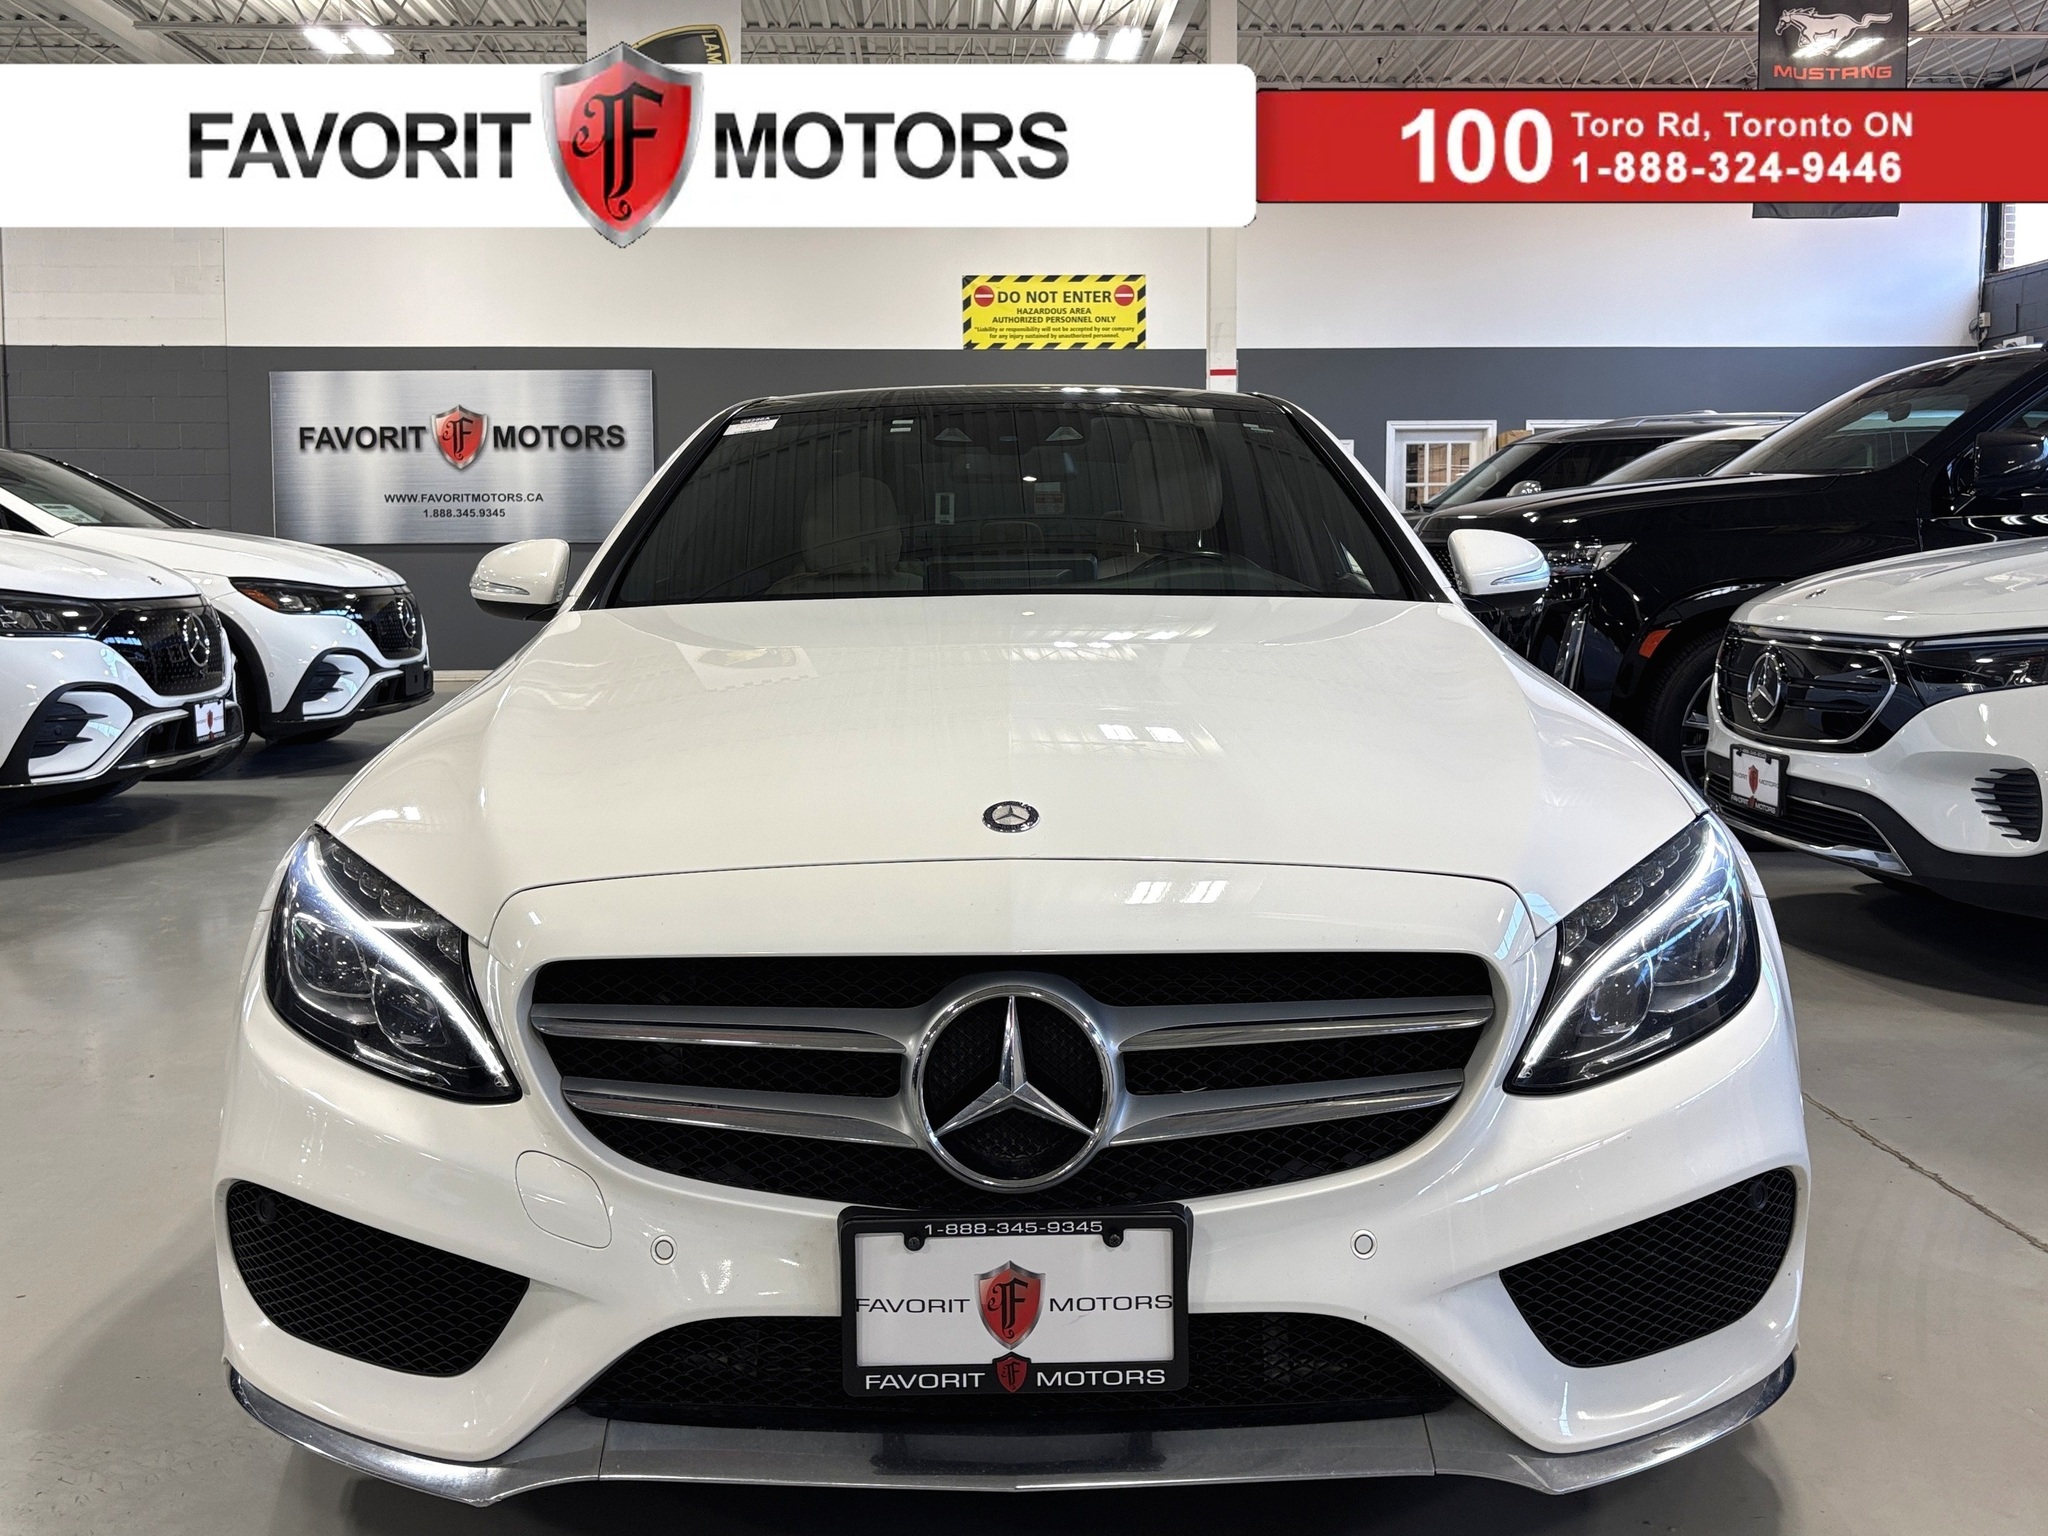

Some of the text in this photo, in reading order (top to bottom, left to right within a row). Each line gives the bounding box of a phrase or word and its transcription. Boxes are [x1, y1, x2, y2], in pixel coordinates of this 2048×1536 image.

[1773, 65, 1892, 81] MUSTANG
[997, 290, 1112, 304] DO NOT ENTER
[1016, 307, 1092, 315] HAZARDOUS AREA
[992, 316, 1044, 324] AUTHORIZED
[299, 426, 427, 451] FAVORIT
[493, 425, 626, 449] MOTORS
[384, 493, 544, 503] WWW.FAVORITMOTORS.CA
[423, 508, 506, 518] 1.888.345.9345
[924, 1221, 1103, 1236] 1-888-345-9345
[855, 1298, 970, 1314] FAVORIT
[1050, 1294, 1173, 1312] MOTORS
[865, 1372, 986, 1390] FAVORIT
[1036, 1369, 1166, 1387] MOTORS
